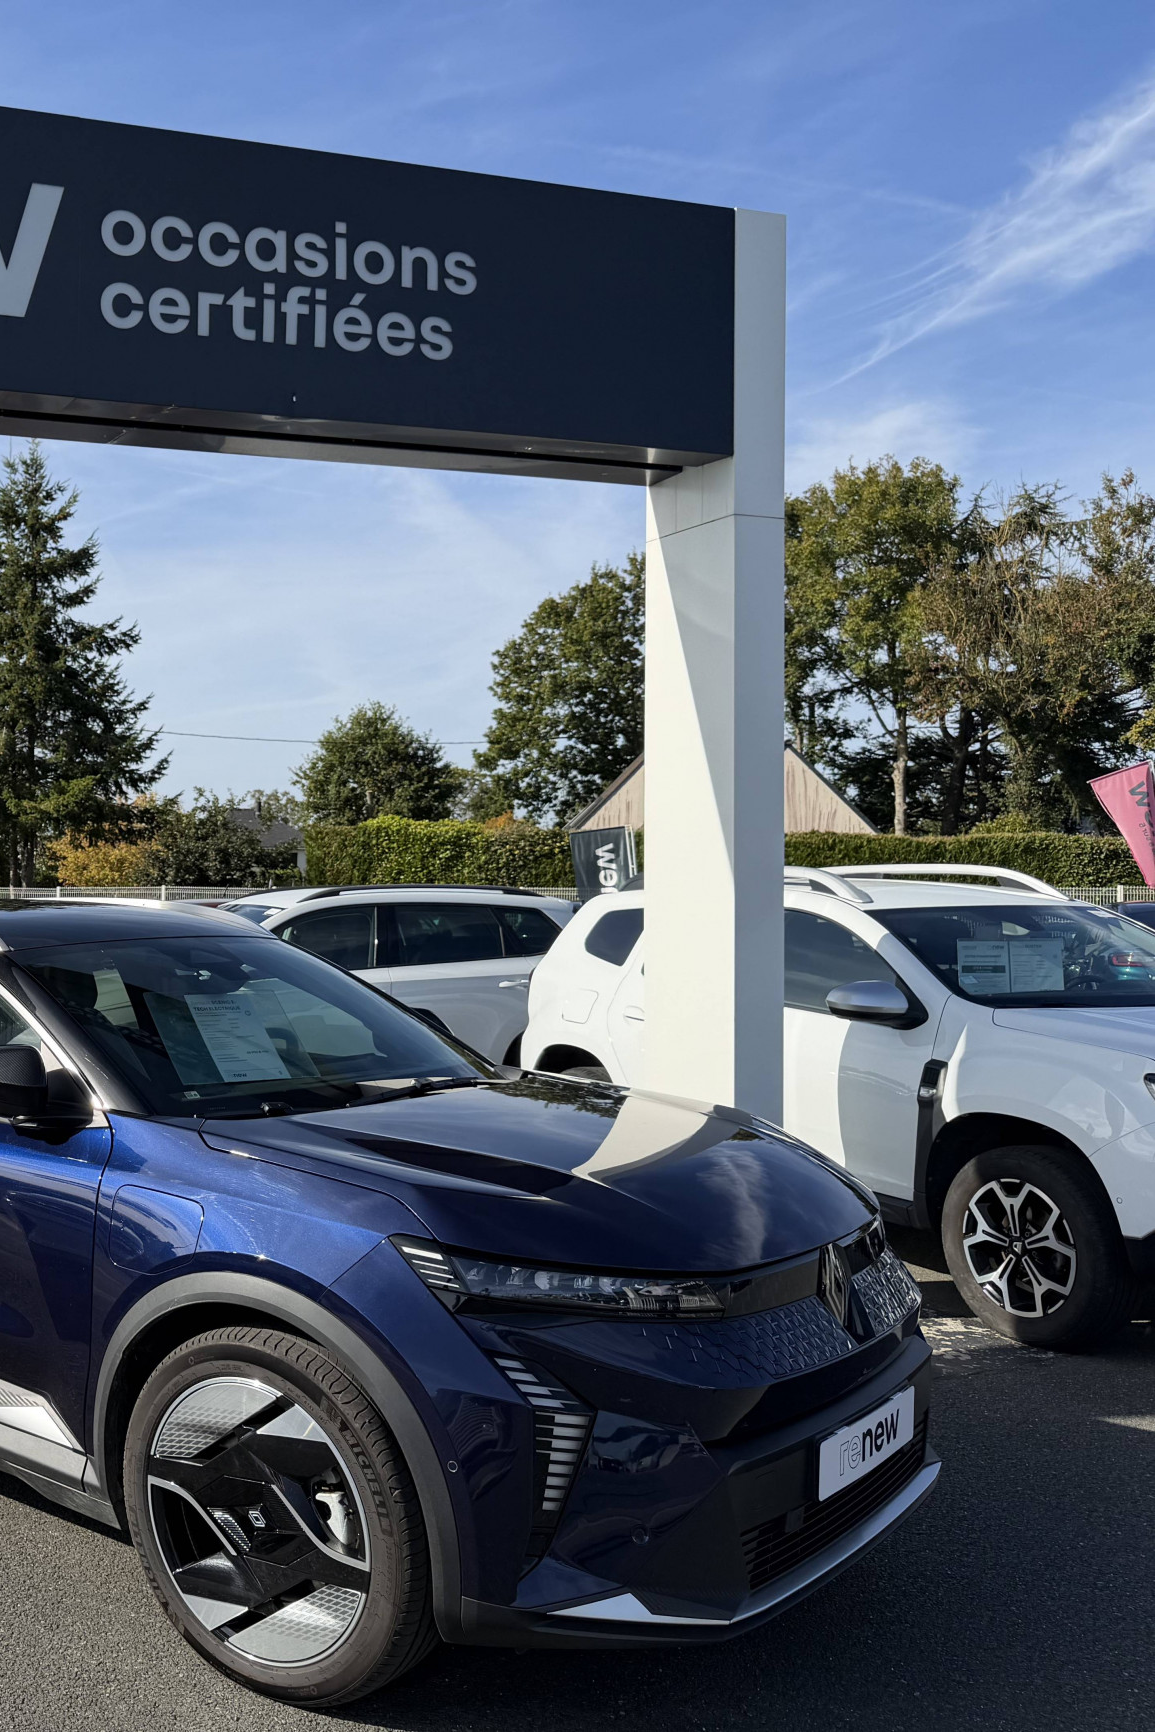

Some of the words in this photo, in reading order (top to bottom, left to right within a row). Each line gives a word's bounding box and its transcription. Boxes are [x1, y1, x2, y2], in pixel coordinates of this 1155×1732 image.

[100, 209, 478, 296] occasions
[100, 281, 454, 361] certifiées
[341, 1426, 393, 1538] MICHELIN
[839, 1408, 900, 1477] renew
